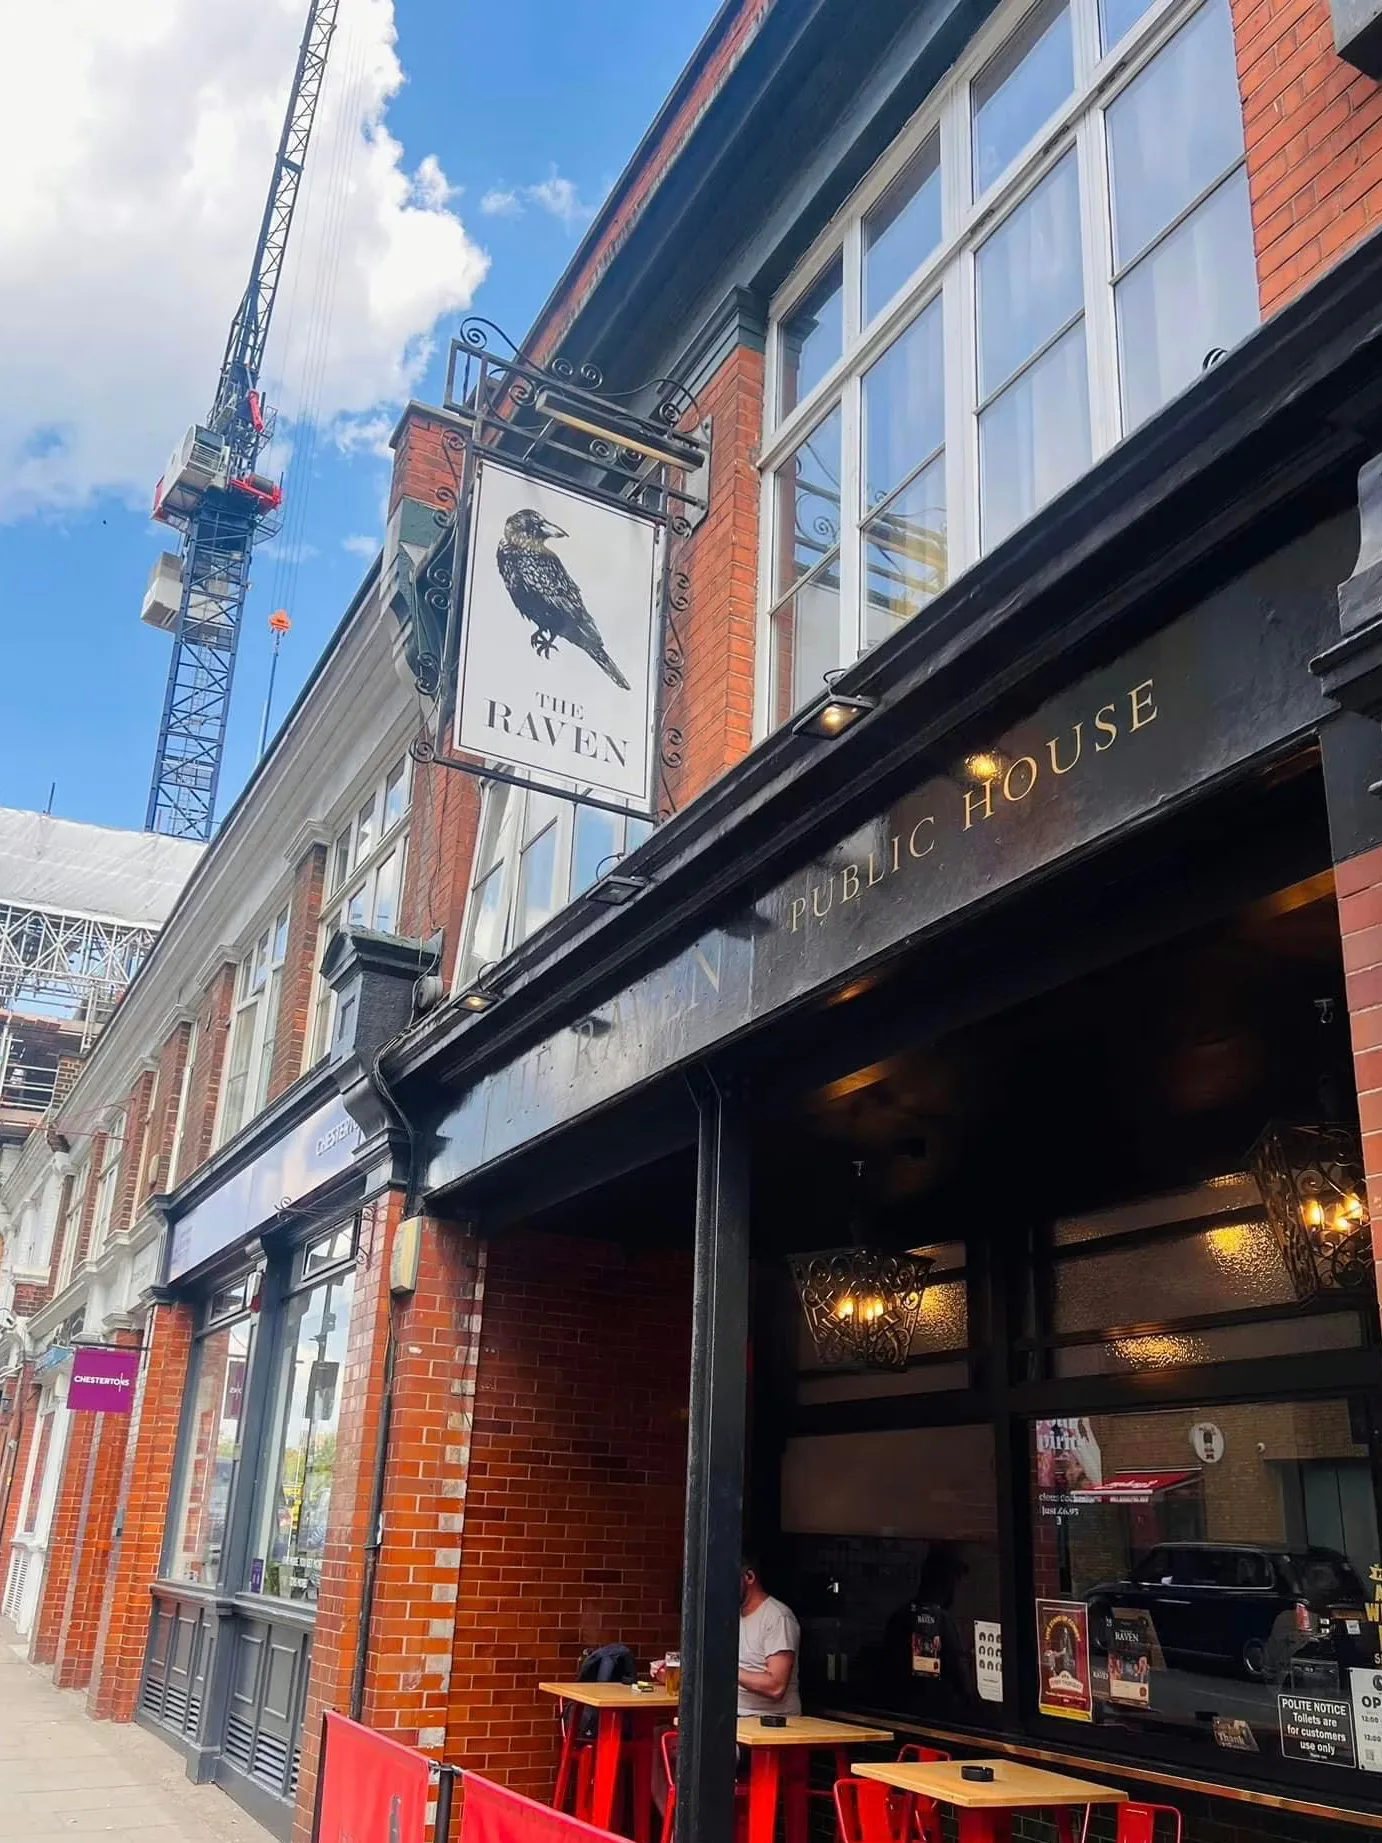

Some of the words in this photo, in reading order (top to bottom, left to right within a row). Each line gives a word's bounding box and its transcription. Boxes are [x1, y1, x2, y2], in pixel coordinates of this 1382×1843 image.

[535, 691, 584, 720] THE
[483, 697, 632, 768] RAVEN
[789, 815, 936, 934] PUBLIC
[962, 679, 1159, 832] HOUSE
[74, 1373, 130, 1390] CHESTERTONS
[1114, 1631, 1140, 1642] RAVEN
[1282, 1698, 1312, 1711] POLITE
[1313, 1702, 1347, 1716] NOTICE
[1293, 1712, 1321, 1725] Toilets
[1322, 1718, 1338, 1727] are
[1287, 1724, 1299, 1735] for
[1301, 1728, 1347, 1742] customers
[1300, 1741, 1316, 1751] use
[1317, 1743, 1336, 1756] only
